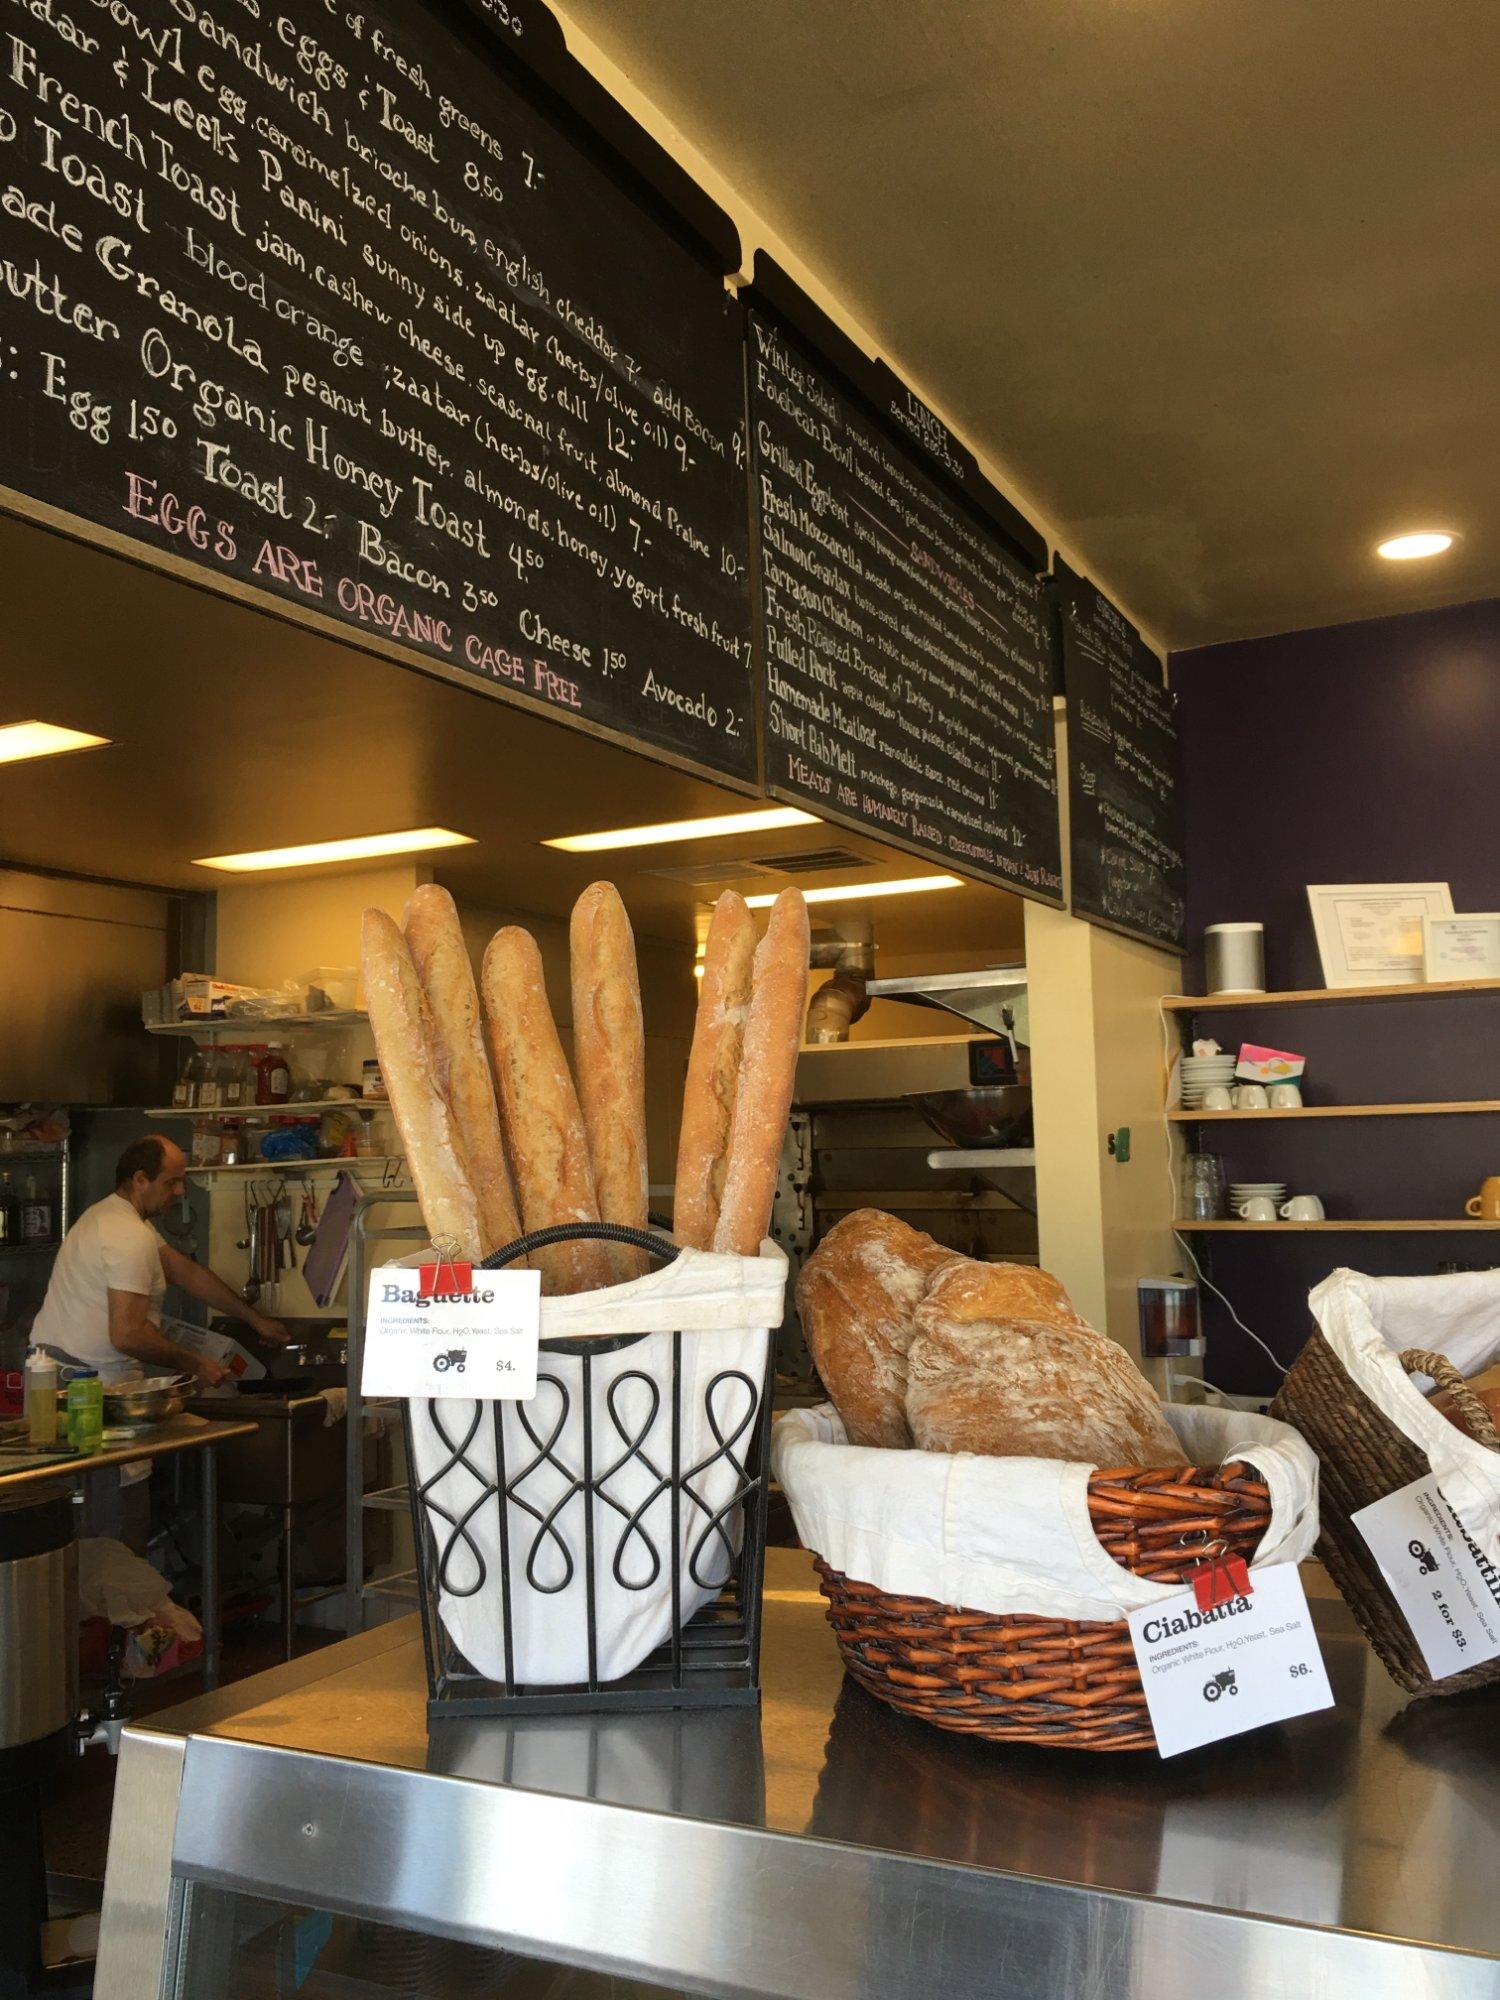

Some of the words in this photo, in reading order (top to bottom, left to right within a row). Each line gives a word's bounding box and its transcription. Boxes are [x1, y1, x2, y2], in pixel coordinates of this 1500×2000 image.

[345, 13, 365, 40] of
[371, 29, 432, 99] fresh
[438, 95, 503, 161] greens
[376, 82, 440, 163] Toast
[463, 161, 503, 201] 8.50
[5, 32, 148, 169] French
[150, 130, 247, 237] Toast
[314, 265, 394, 325] cashew
[605, 468, 663, 522] almond
[667, 507, 711, 558] Praline
[258, 149, 347, 246] Panini
[362, 243, 426, 309] sunny
[433, 295, 476, 338] side
[483, 333, 505, 365] up
[344, 118, 428, 209] brioche
[484, 238, 549, 304] english
[653, 386, 681, 419] add
[683, 405, 725, 458] Bacon
[33, 116, 151, 233] Toast
[182, 225, 270, 312] blood
[274, 298, 364, 367] orange
[588, 502, 618, 533] oil)
[752, 321, 805, 395] Winter
[806, 373, 838, 424] Salad
[95, 234, 269, 374] Granola
[282, 364, 372, 424] peanut
[671, 593, 709, 640] fresh
[710, 620, 740, 660] fruit
[140, 327, 296, 451] Organic
[305, 417, 405, 518] Honey
[411, 476, 491, 559] Toast
[821, 423, 853, 473] Bowl
[907, 392, 947, 451] LUNCH
[758, 420, 806, 489] Grilled
[803, 459, 850, 529] Eggplant
[40, 351, 112, 444] Egg
[196, 436, 293, 520] Toast
[358, 520, 452, 600] Bacon
[519, 608, 592, 668] Cheese
[641, 668, 718, 728] Avocado
[760, 473, 798, 527] Fresh
[798, 507, 863, 577] Mozzarella
[763, 514, 809, 572] Salmon
[806, 549, 852, 600] Gravlax
[122, 470, 237, 561] EGGS
[251, 539, 324, 598] ARE
[337, 576, 454, 652] ORGANIC
[465, 634, 526, 685] CAGE
[532, 658, 582, 708] FREE
[762, 545, 822, 612] Tarragon
[821, 594, 863, 640] Chicken
[765, 585, 807, 641] Fresh
[805, 616, 852, 668] Roasted
[852, 646, 890, 690] Breast
[892, 674, 903, 697] of
[904, 679, 934, 724] Turkey
[766, 624, 807, 674] Pulled
[808, 648, 839, 691] Pork
[766, 660, 831, 724] Homemade
[831, 701, 877, 750] Meatloaf
[769, 700, 808, 751] Short
[808, 723, 830, 765] Rib
[828, 737, 858, 779] Melt
[787, 753, 833, 795] MEATS
[836, 783, 859, 807] ARE
[862, 793, 909, 828] HUMANELY
[379, 1327, 408, 1336] Organic
[409, 1326, 431, 1335] White
[494, 1327, 510, 1335] Sea
[510, 1327, 523, 1335] Salt
[380, 1317, 430, 1325] INGREDIENTS:
[496, 1360, 516, 1372] $4.
[1422, 1491, 1454, 1540] INGREDIENTS:
[1415, 1494, 1435, 1528] Organic
[1432, 1523, 1447, 1547] White
[1476, 1611, 1489, 1629] Sea
[1485, 1624, 1498, 1644] Salt
[1142, 1595, 1254, 1645] Ciabatta
[1148, 1640, 1200, 1663] INGREDIENTS:
[1151, 1654, 1182, 1675] Organic
[1181, 1650, 1204, 1664] White
[1268, 1625, 1286, 1636] Sea
[1286, 1620, 1302, 1631] Salt
[1431, 1589, 1443, 1601] 2
[1438, 1602, 1454, 1626] for
[1451, 1628, 1468, 1653] $3.
[1289, 1662, 1313, 1679] $6.
